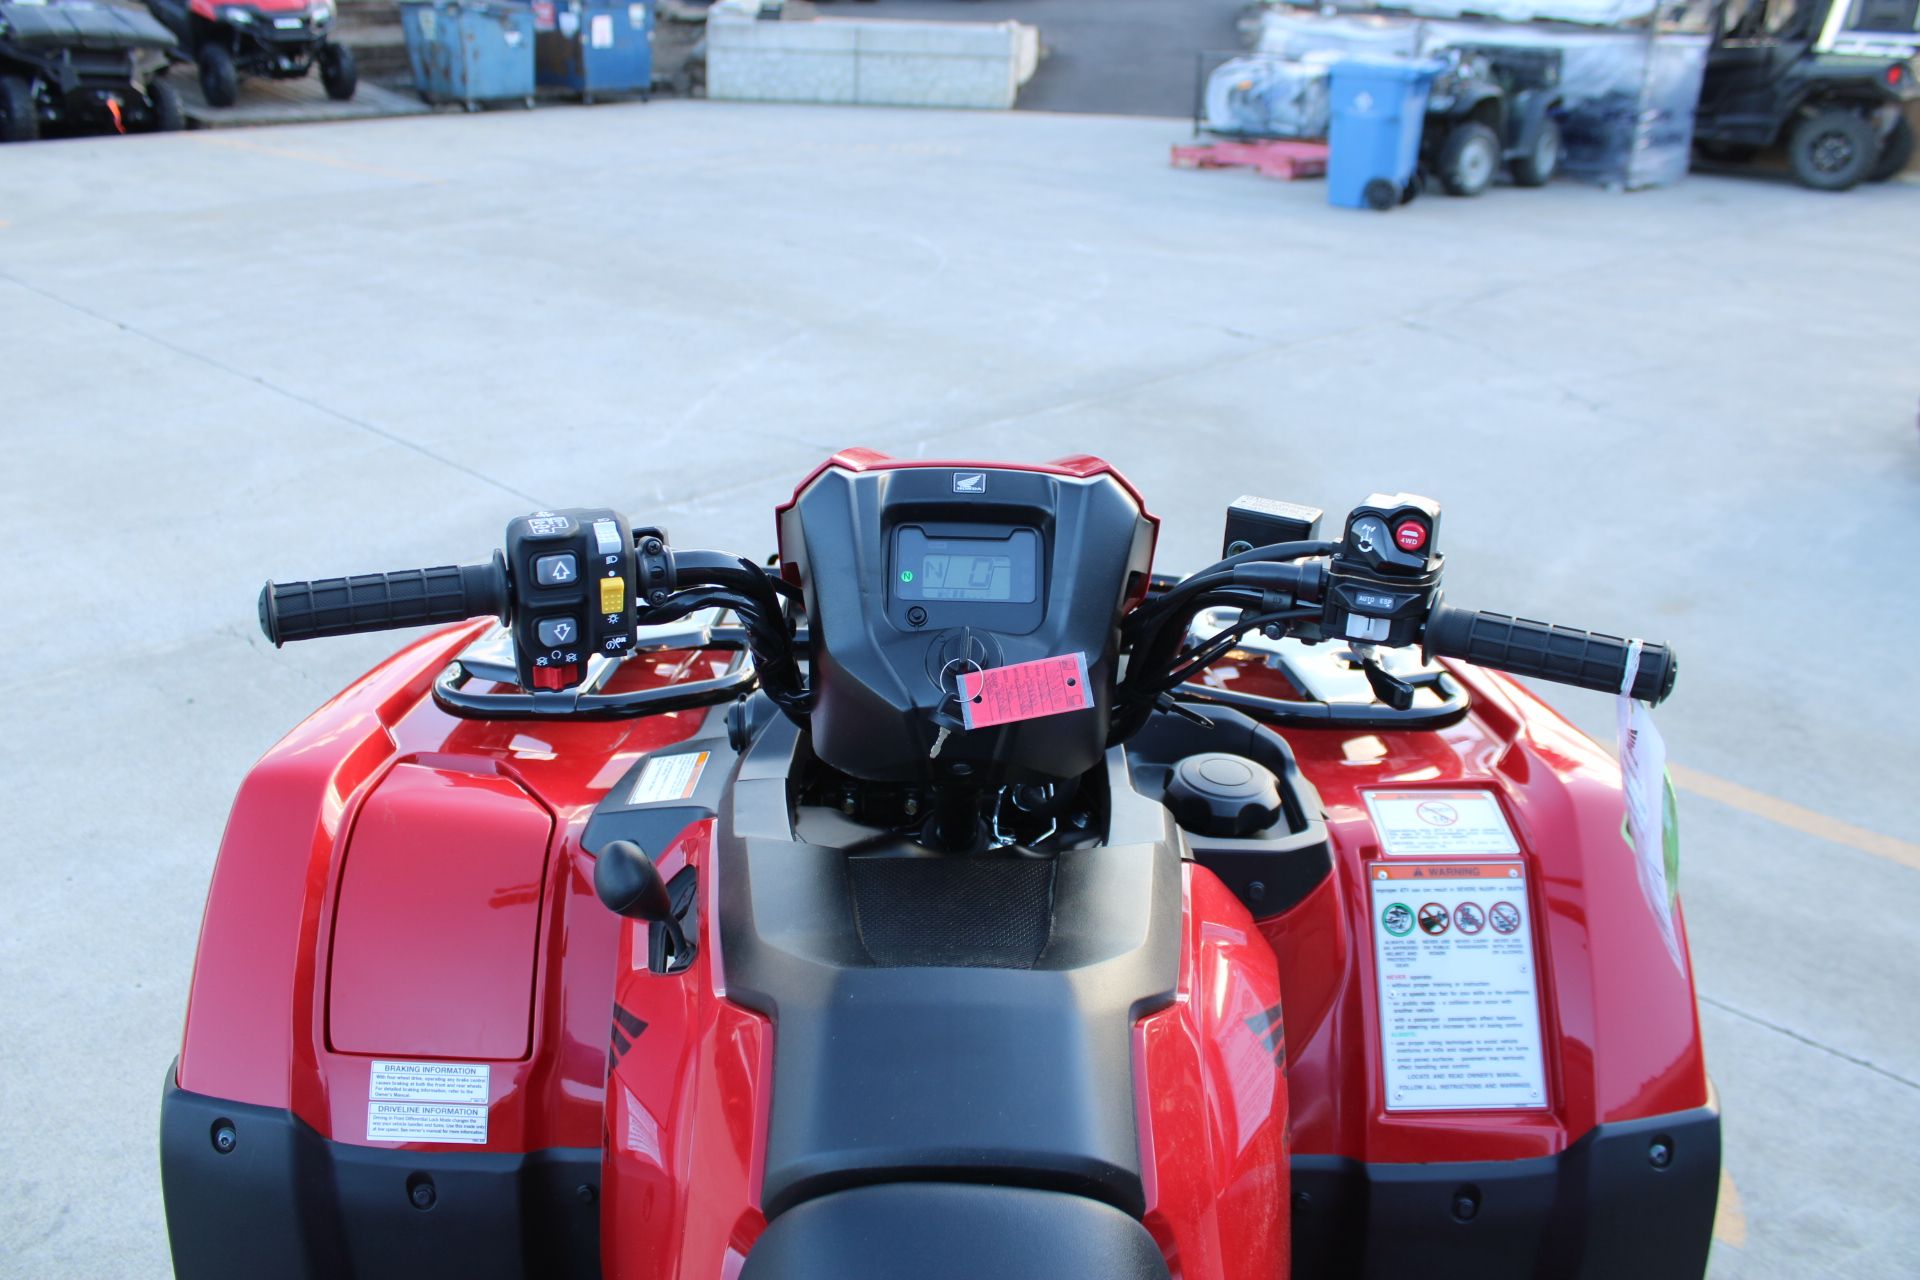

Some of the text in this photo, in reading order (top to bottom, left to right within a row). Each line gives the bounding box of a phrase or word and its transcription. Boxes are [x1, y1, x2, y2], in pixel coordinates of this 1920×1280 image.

[925, 558, 994, 587] N 0
[1428, 867, 1480, 876] WARNING
[422, 1066, 476, 1074] INFORMATION
[422, 1107, 479, 1115] INFORMATION
